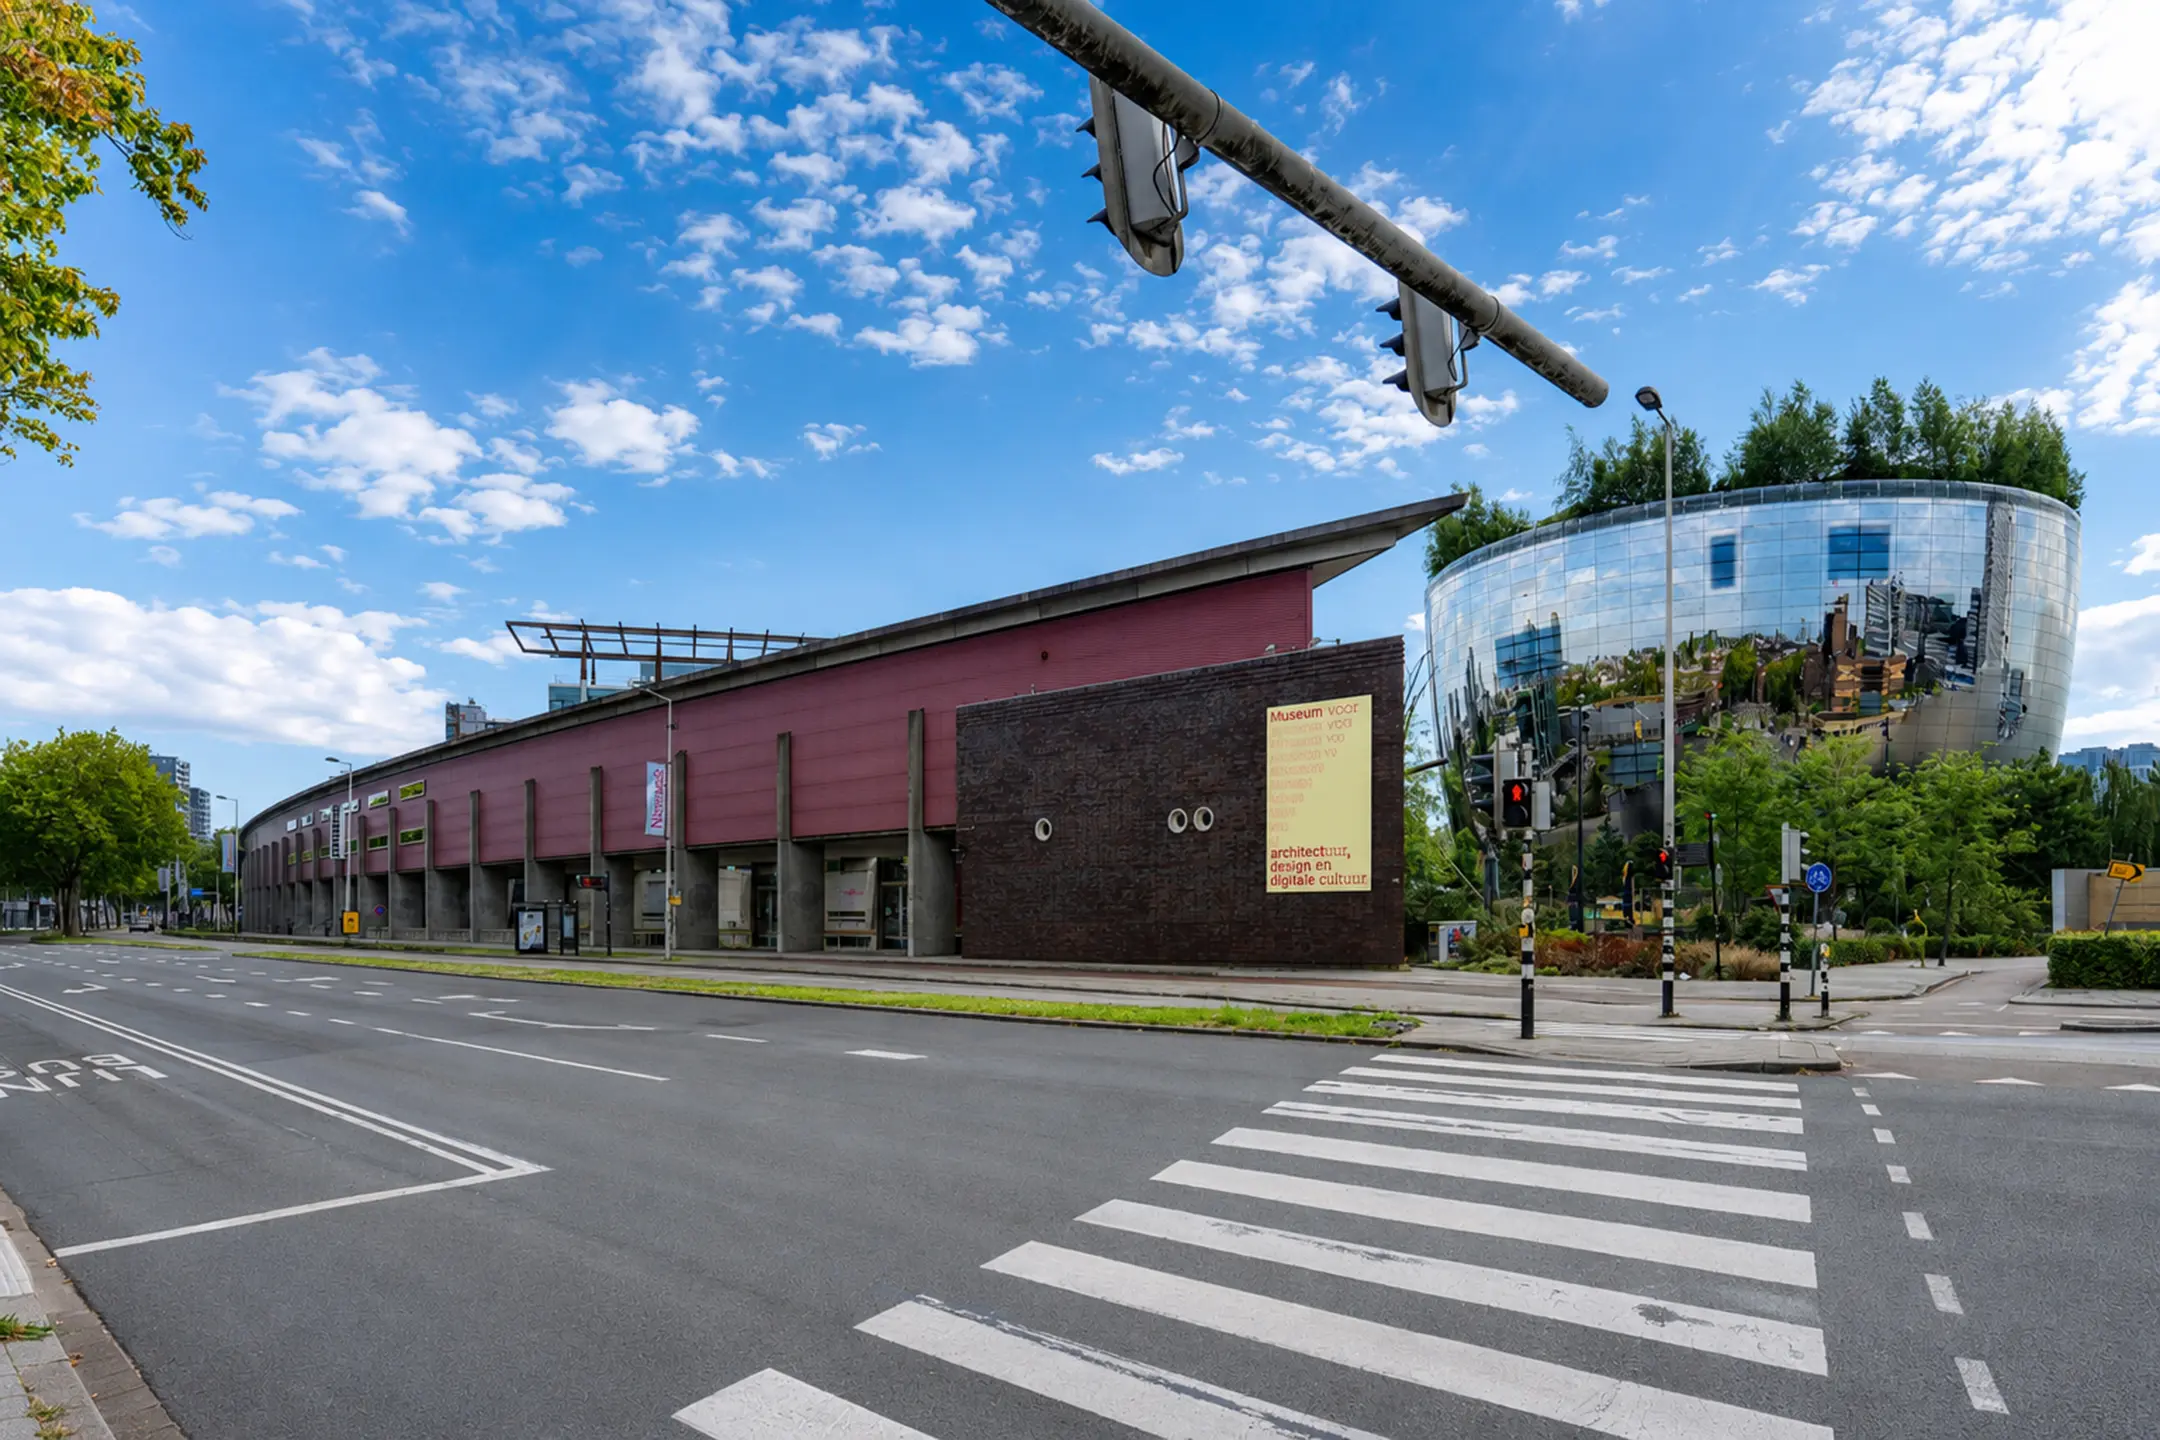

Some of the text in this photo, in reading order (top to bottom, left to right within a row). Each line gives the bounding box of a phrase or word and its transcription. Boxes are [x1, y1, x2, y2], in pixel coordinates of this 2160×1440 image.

[1270, 703, 1359, 722] Museum voor
[1270, 845, 1351, 859] architectuur,
[1270, 860, 1332, 874] design en
[1270, 873, 1315, 889] digitale
